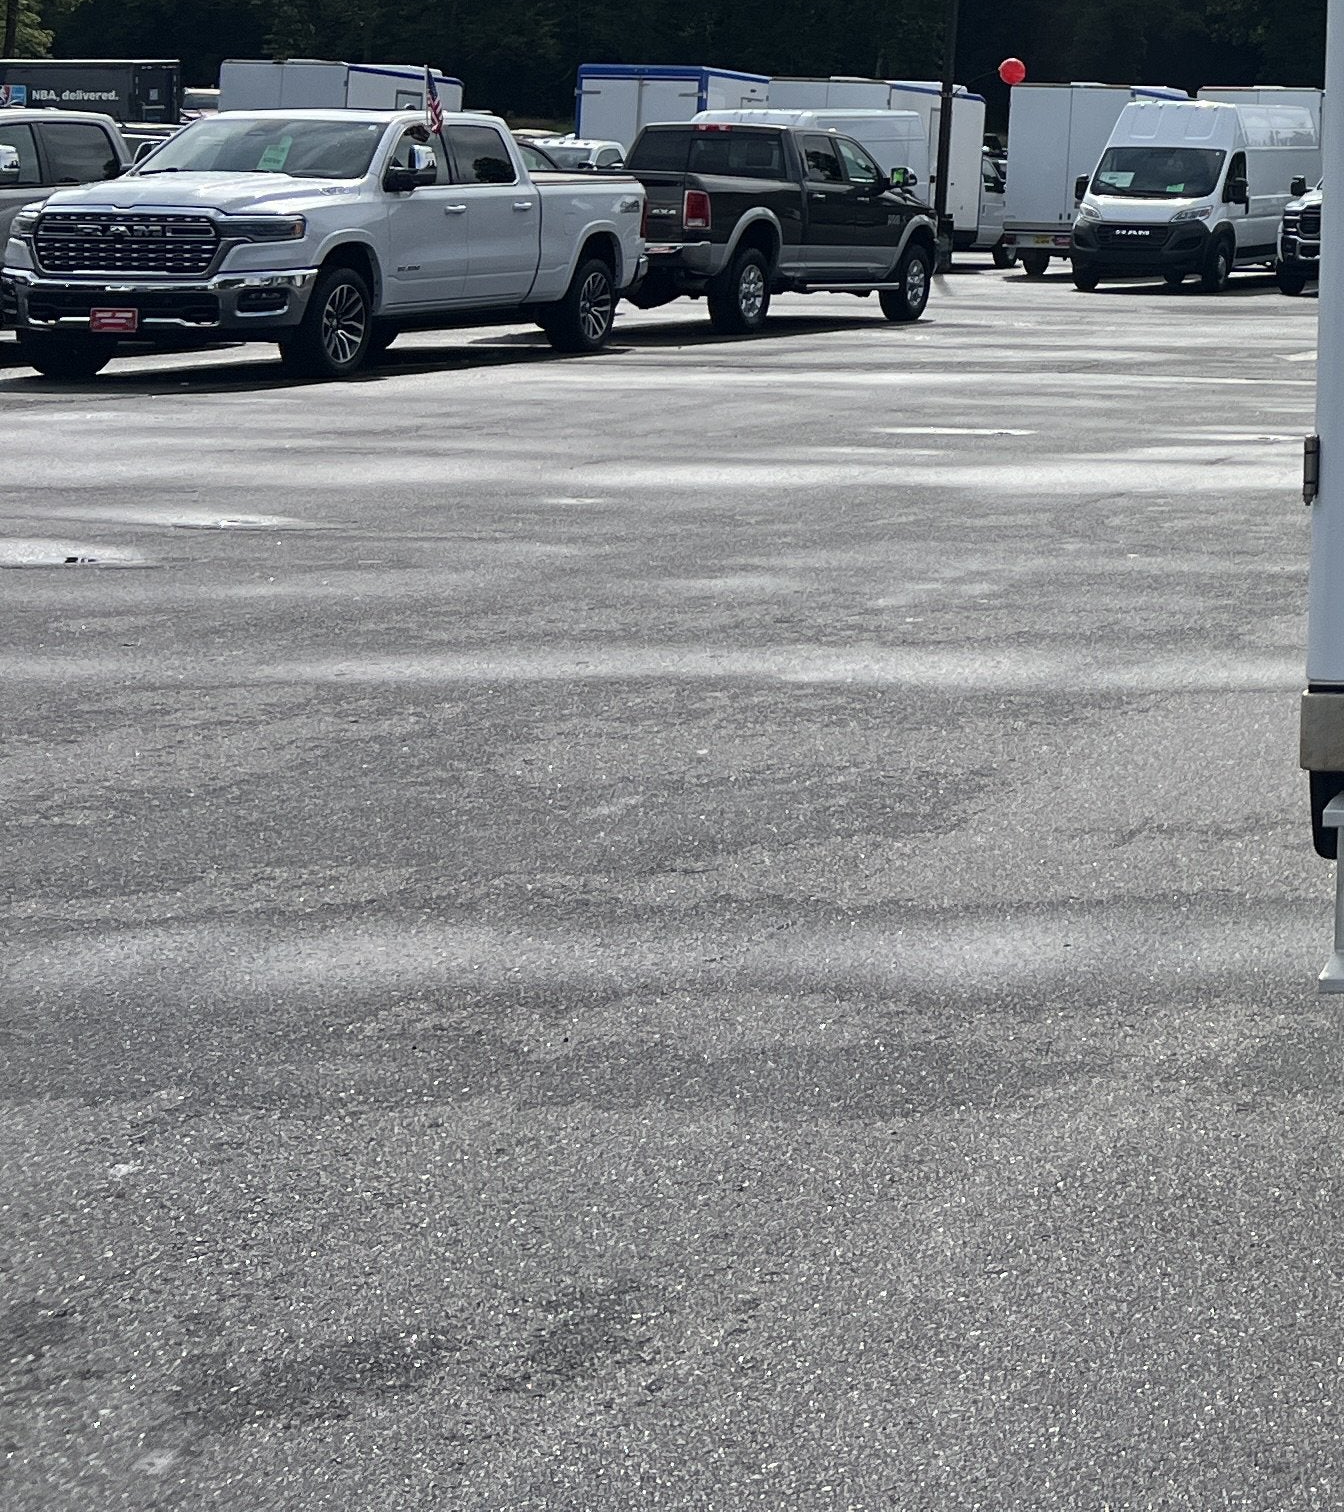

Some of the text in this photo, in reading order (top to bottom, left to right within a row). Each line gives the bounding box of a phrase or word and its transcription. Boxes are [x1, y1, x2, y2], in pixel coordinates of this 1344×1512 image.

[31, 89, 119, 102] NBA, delivered.
[76, 224, 163, 236] RAM
